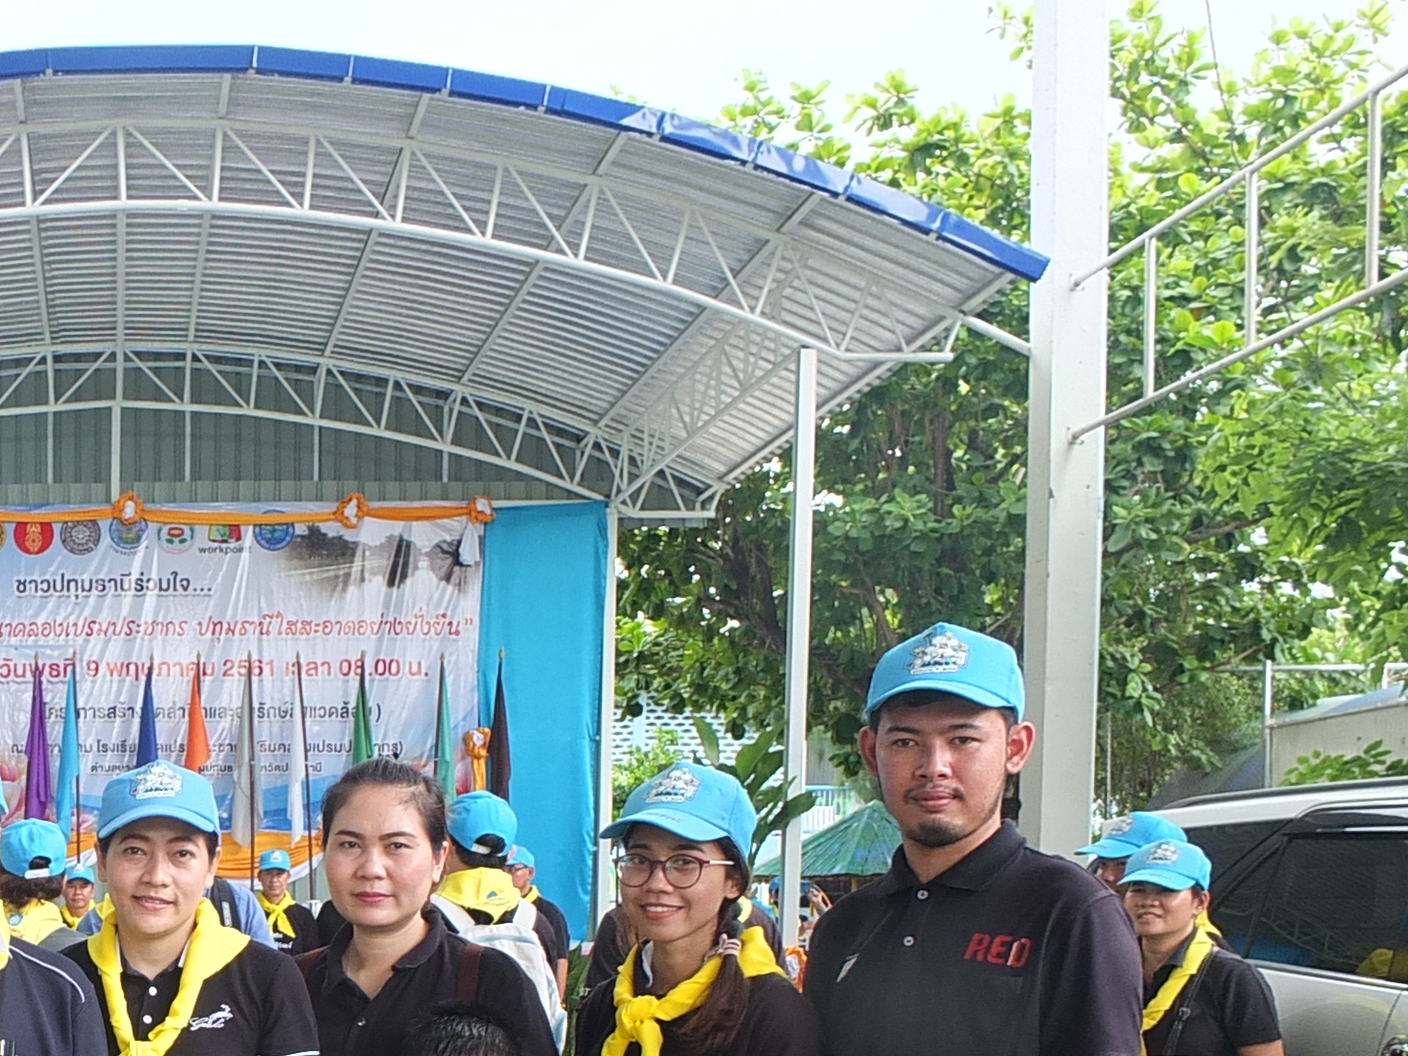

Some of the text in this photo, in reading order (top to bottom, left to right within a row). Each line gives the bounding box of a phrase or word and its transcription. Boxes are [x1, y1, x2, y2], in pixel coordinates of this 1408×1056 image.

[15, 572, 213, 600] ชาวปทุมธานีร่วมใจ...
[86, 658, 99, 678] 9
[222, 658, 275, 678] 2561
[338, 658, 401, 678] 08.00
[408, 661, 429, 678] น.
